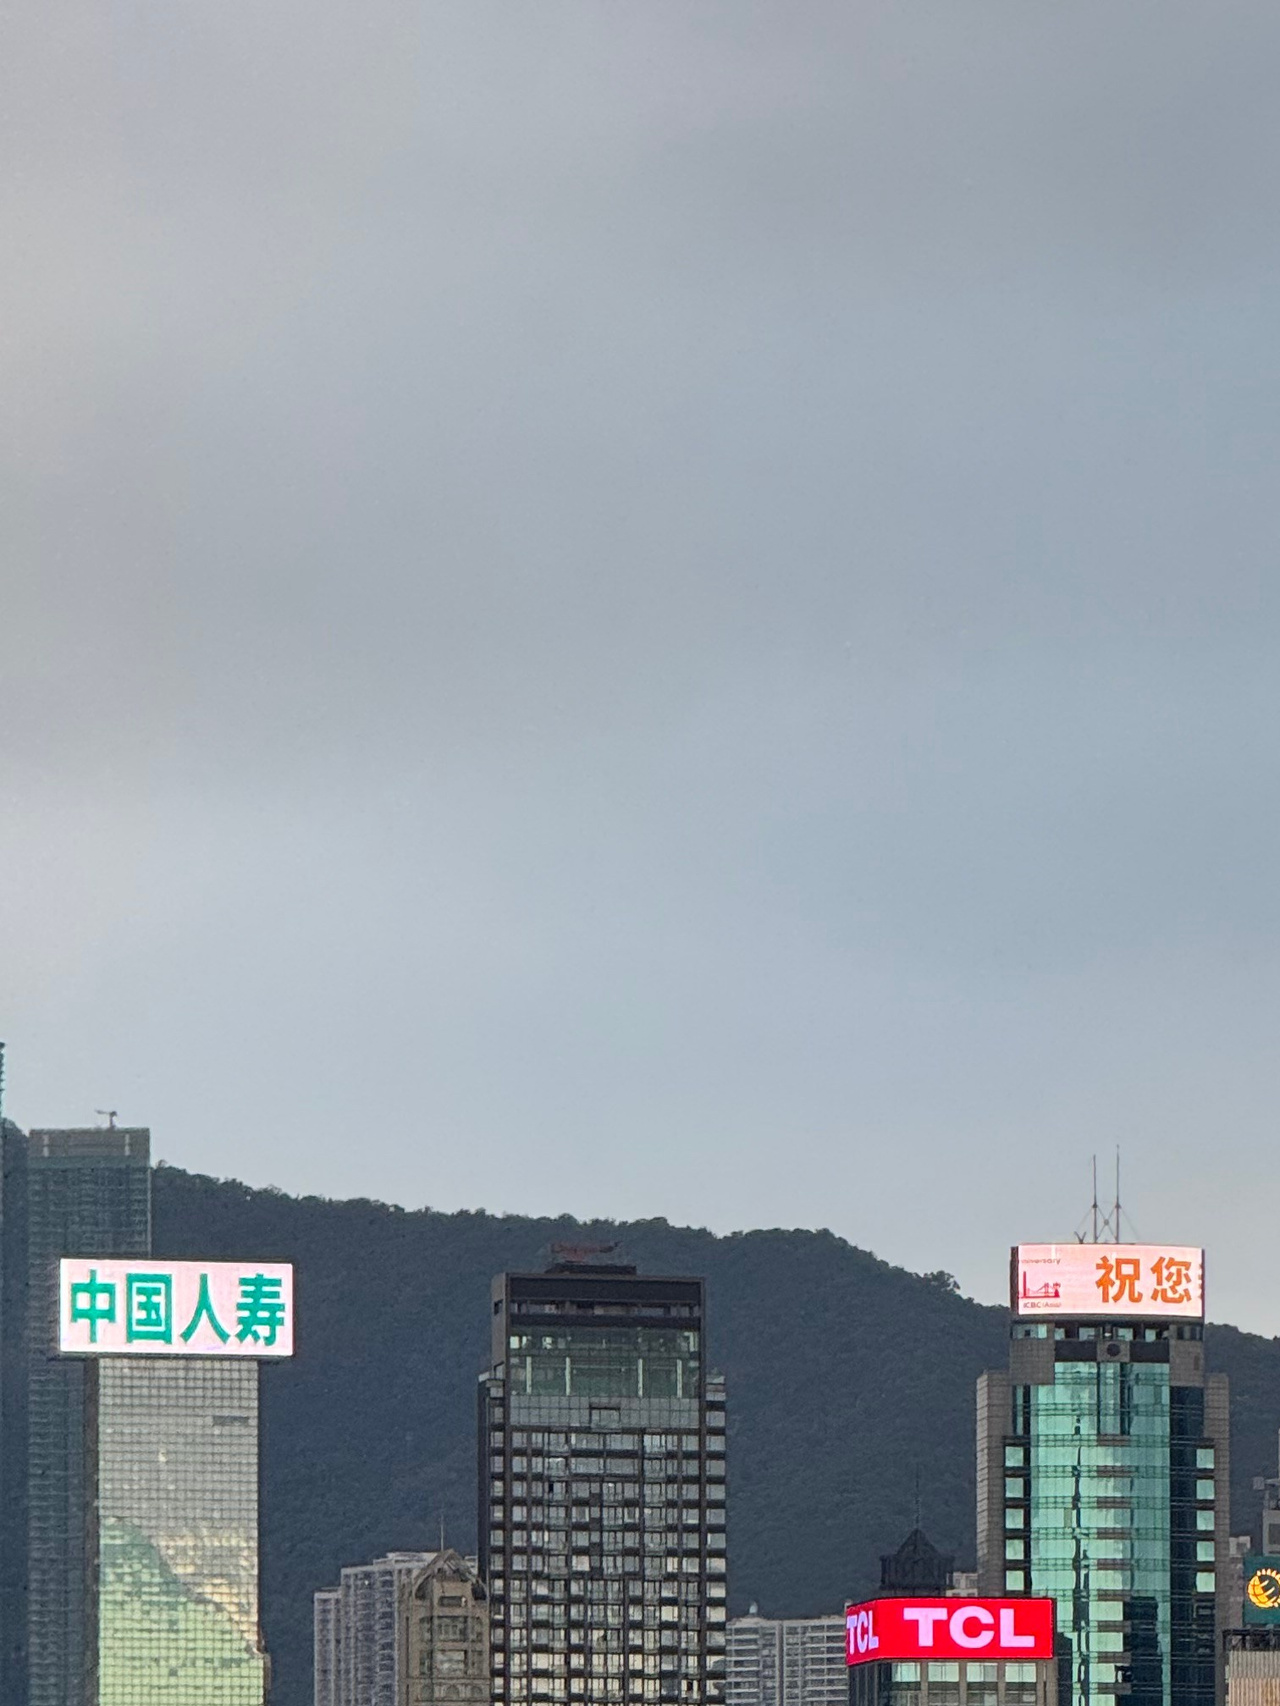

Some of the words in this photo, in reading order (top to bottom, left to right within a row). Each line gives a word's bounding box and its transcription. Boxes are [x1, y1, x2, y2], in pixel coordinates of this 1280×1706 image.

[1095, 1255, 1203, 1304] 祝您
[71, 1269, 286, 1346] 中国人寿
[847, 1610, 879, 1655] TCL
[903, 1606, 1035, 1648] TCL
